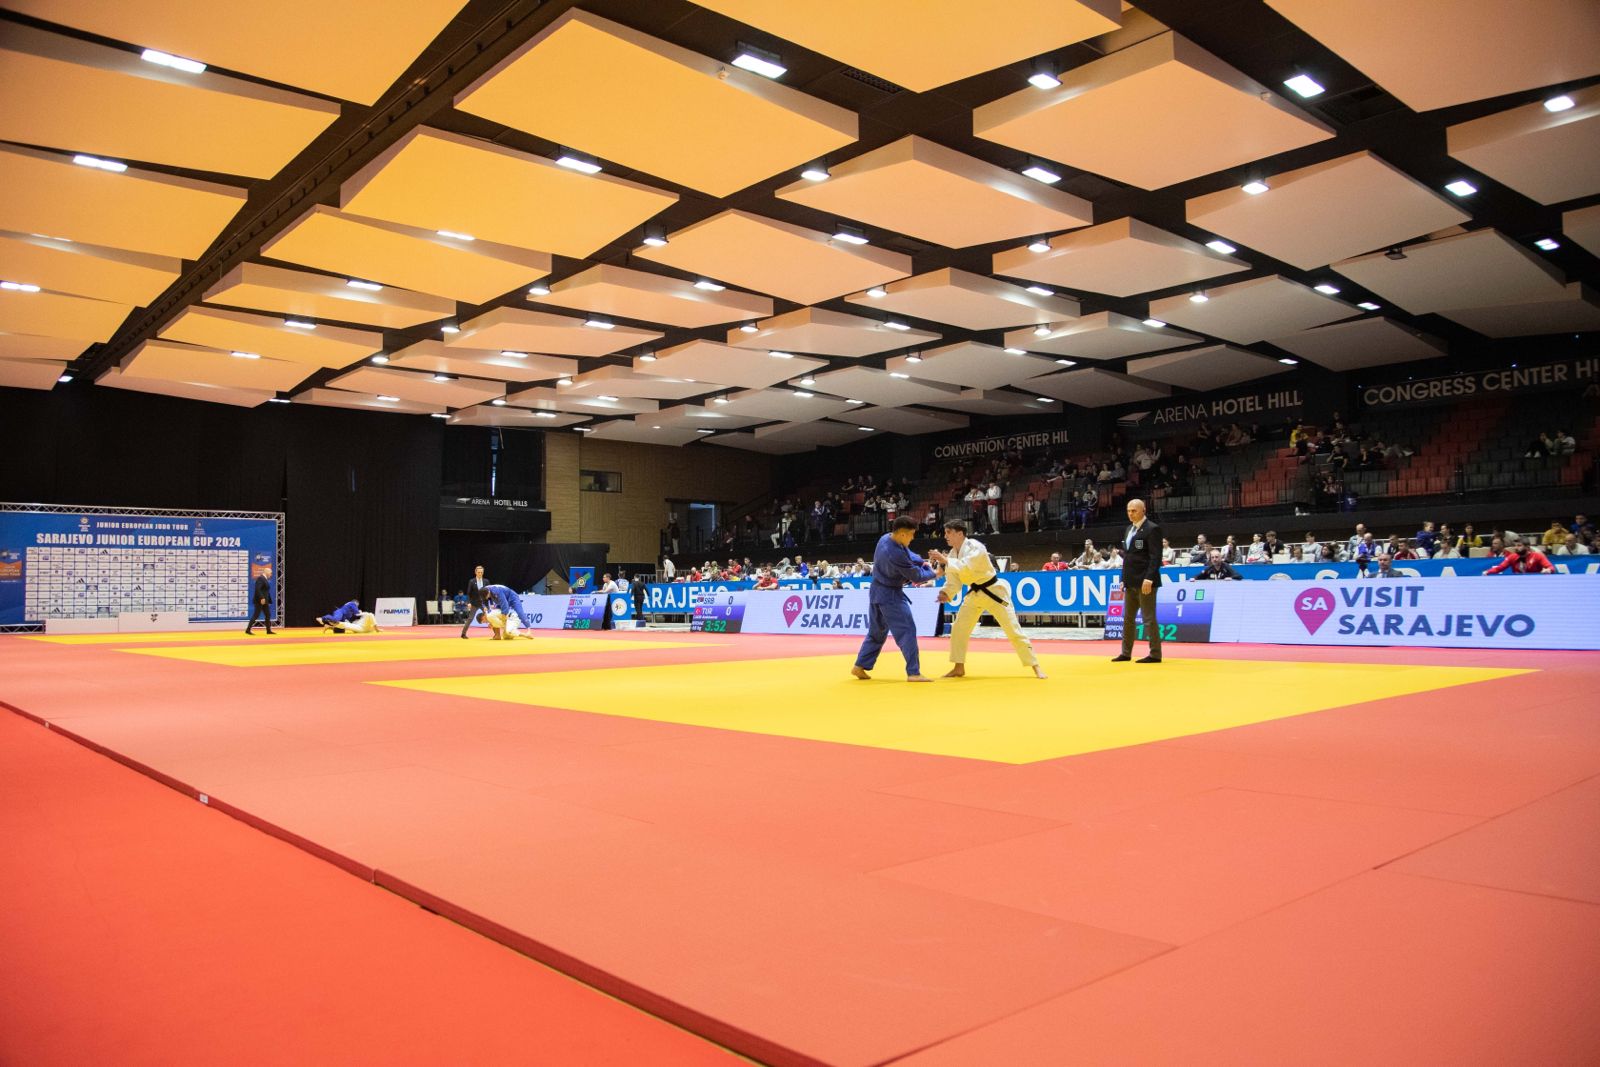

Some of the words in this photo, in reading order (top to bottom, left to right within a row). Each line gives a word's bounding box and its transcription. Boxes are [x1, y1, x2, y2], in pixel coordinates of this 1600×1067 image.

[1364, 376, 1476, 405] CONGRESS
[1483, 363, 1568, 391] CENTER
[1153, 404, 1208, 424] ARENA
[1212, 395, 1263, 416] HOTEL
[934, 440, 1005, 458] CONVENTION
[1008, 433, 1049, 450] CENTER
[36, 533, 93, 544] SARAJEVO
[96, 534, 135, 545] JUNIOR
[138, 535, 191, 546] EUROPEAN
[193, 536, 214, 547] CUP
[215, 537, 241, 547] 2024
[728, 596, 734, 605] 0
[805, 595, 844, 609] VISIT
[1176, 588, 1187, 602] 0
[1340, 585, 1425, 608] VISIT
[786, 602, 799, 612] SA
[1175, 604, 1184, 617] 1
[1301, 596, 1328, 611] SA
[702, 607, 713, 615] TUR
[725, 606, 732, 616] 0
[704, 620, 727, 632] 3:52
[1338, 614, 1536, 637] SARAJEVO
